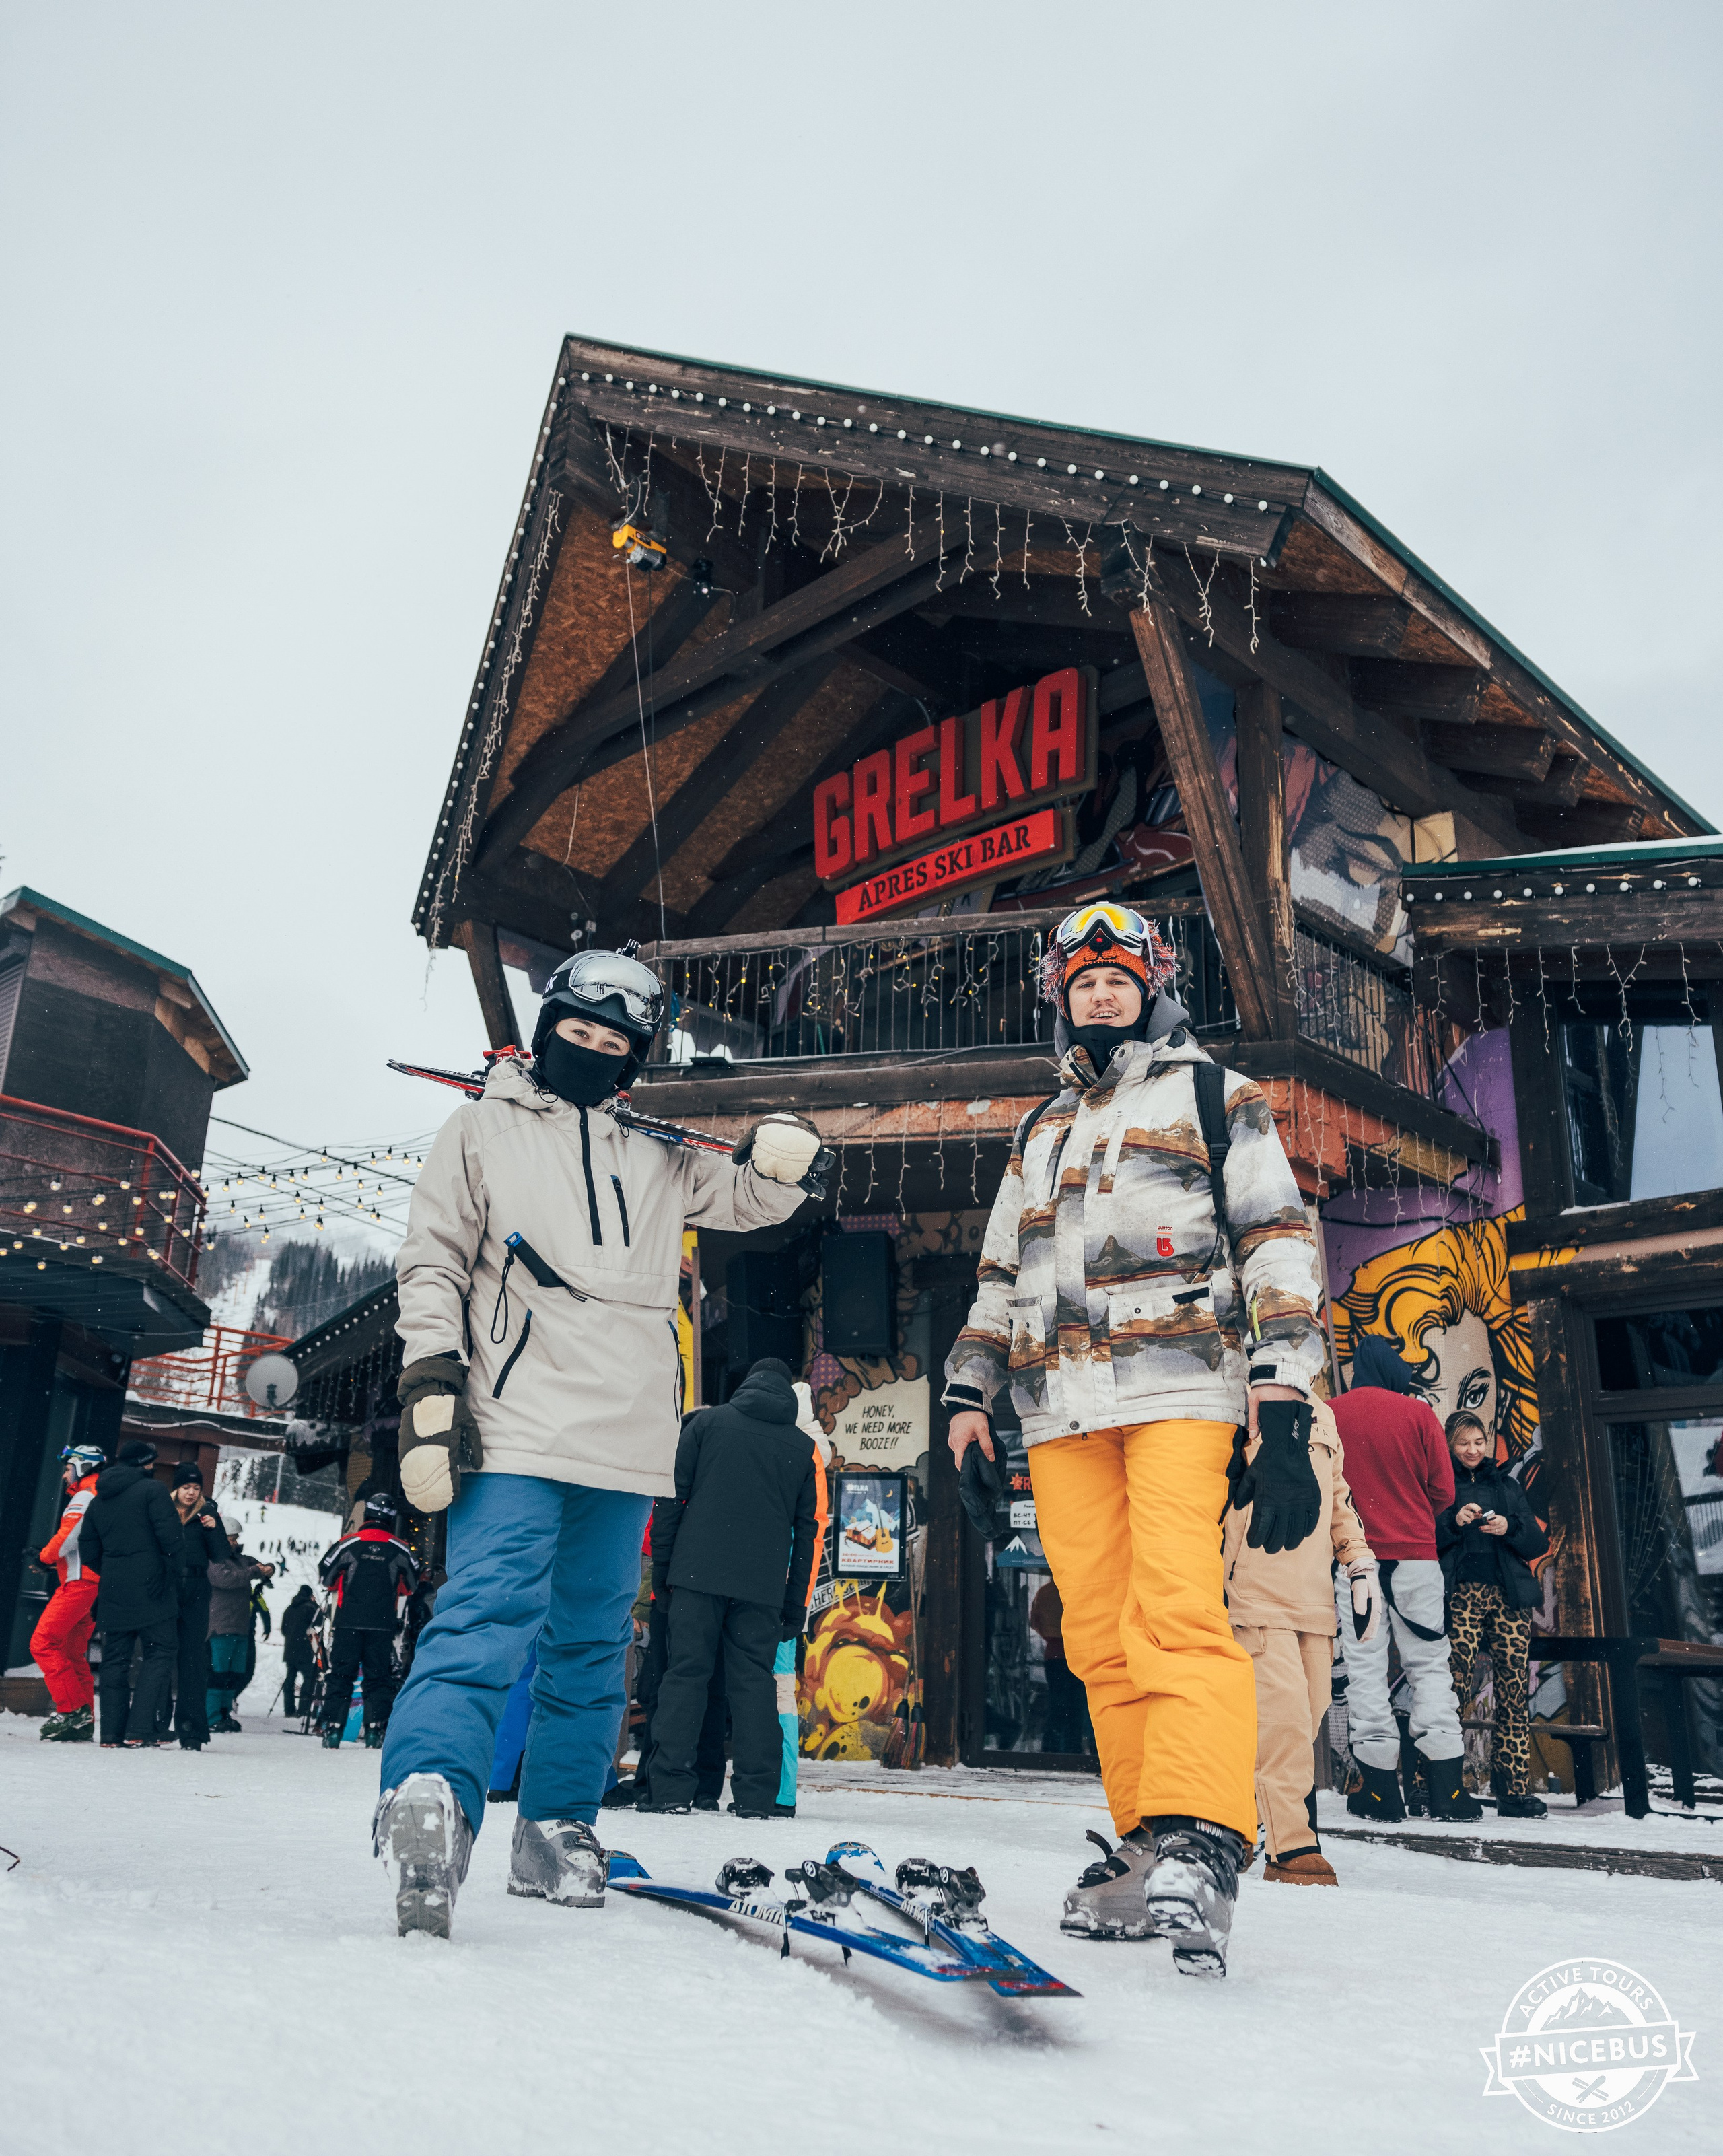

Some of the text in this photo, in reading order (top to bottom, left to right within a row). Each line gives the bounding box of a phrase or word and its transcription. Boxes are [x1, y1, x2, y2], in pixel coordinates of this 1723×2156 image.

[814, 667, 1085, 880] GRELKA
[857, 825, 1032, 912] APRES SKI BAR
[862, 1405, 894, 1418] HONEY,
[845, 1422, 913, 1434] WE NEED MORE
[859, 1437, 899, 1451] BOOZE!!
[845, 1483, 869, 1491] ELKA
